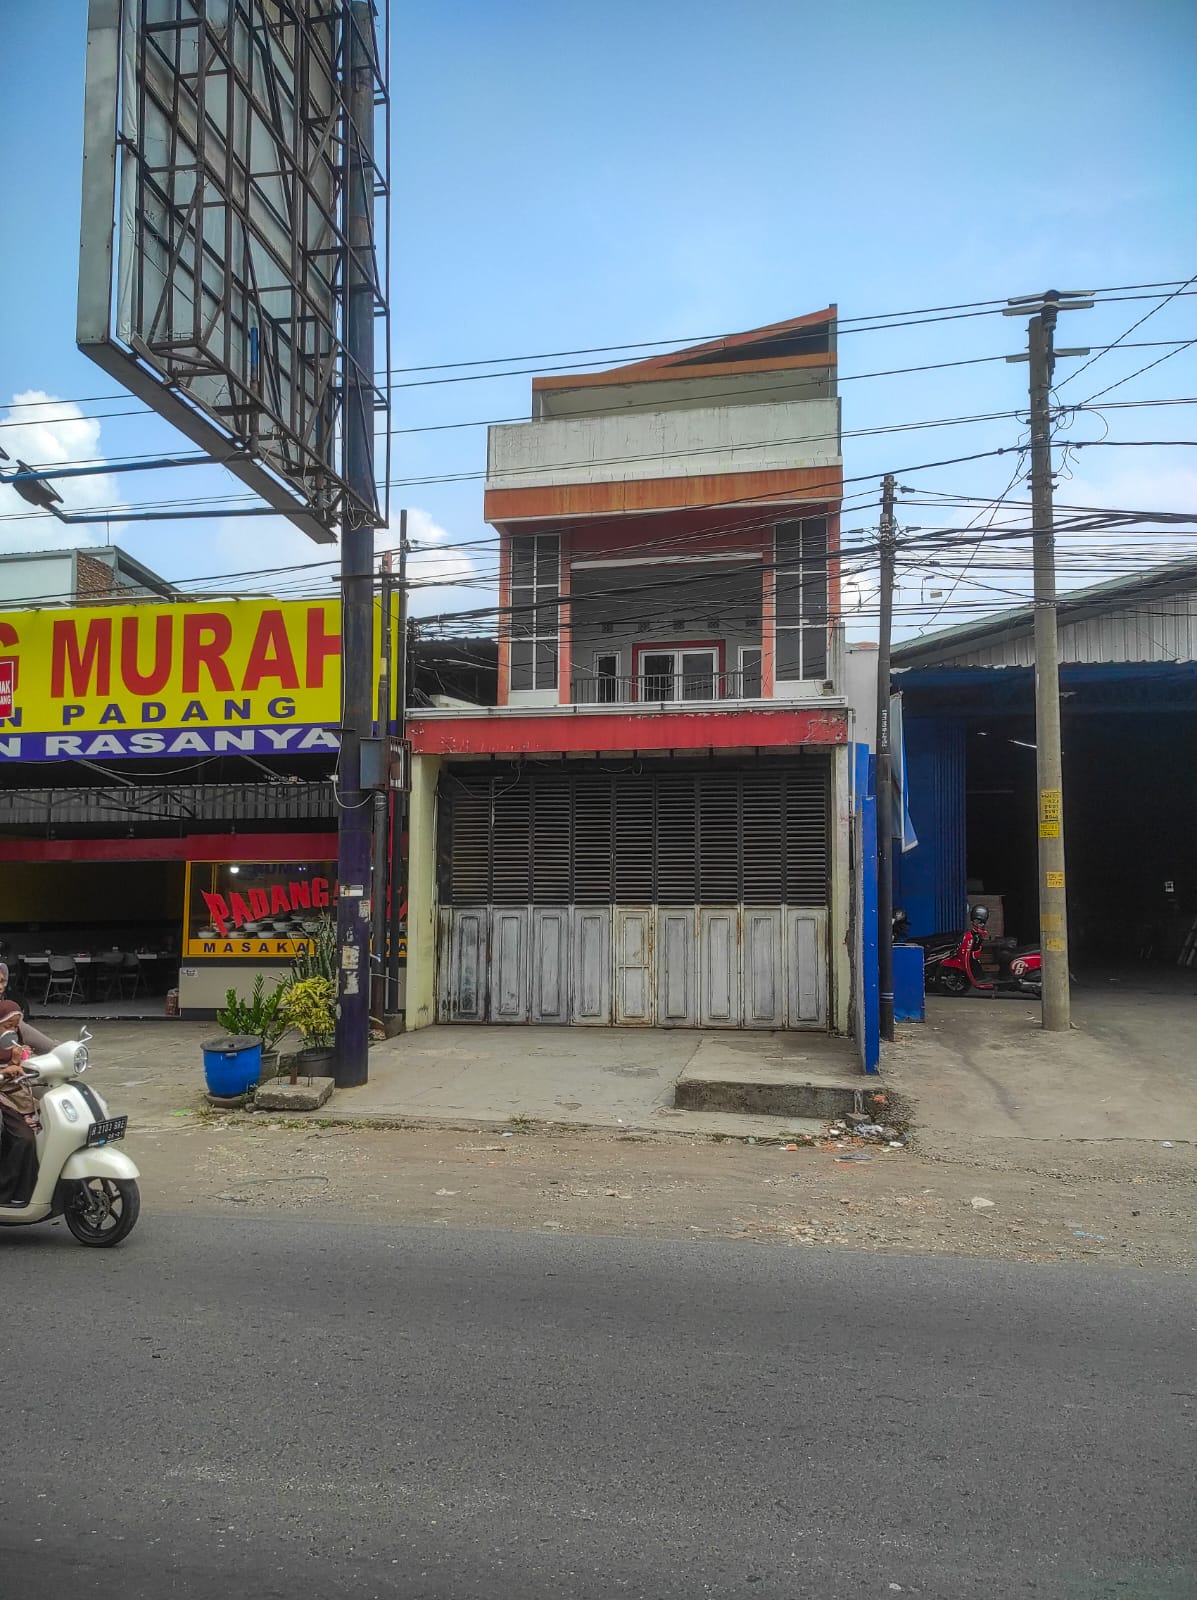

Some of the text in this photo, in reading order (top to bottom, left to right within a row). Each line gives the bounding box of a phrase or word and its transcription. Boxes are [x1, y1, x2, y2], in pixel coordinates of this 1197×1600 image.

[51, 607, 341, 698] MURAH
[62, 697, 296, 726] PADANG
[45, 727, 341, 757] RASANYA
[201, 877, 329, 938] PADANG
